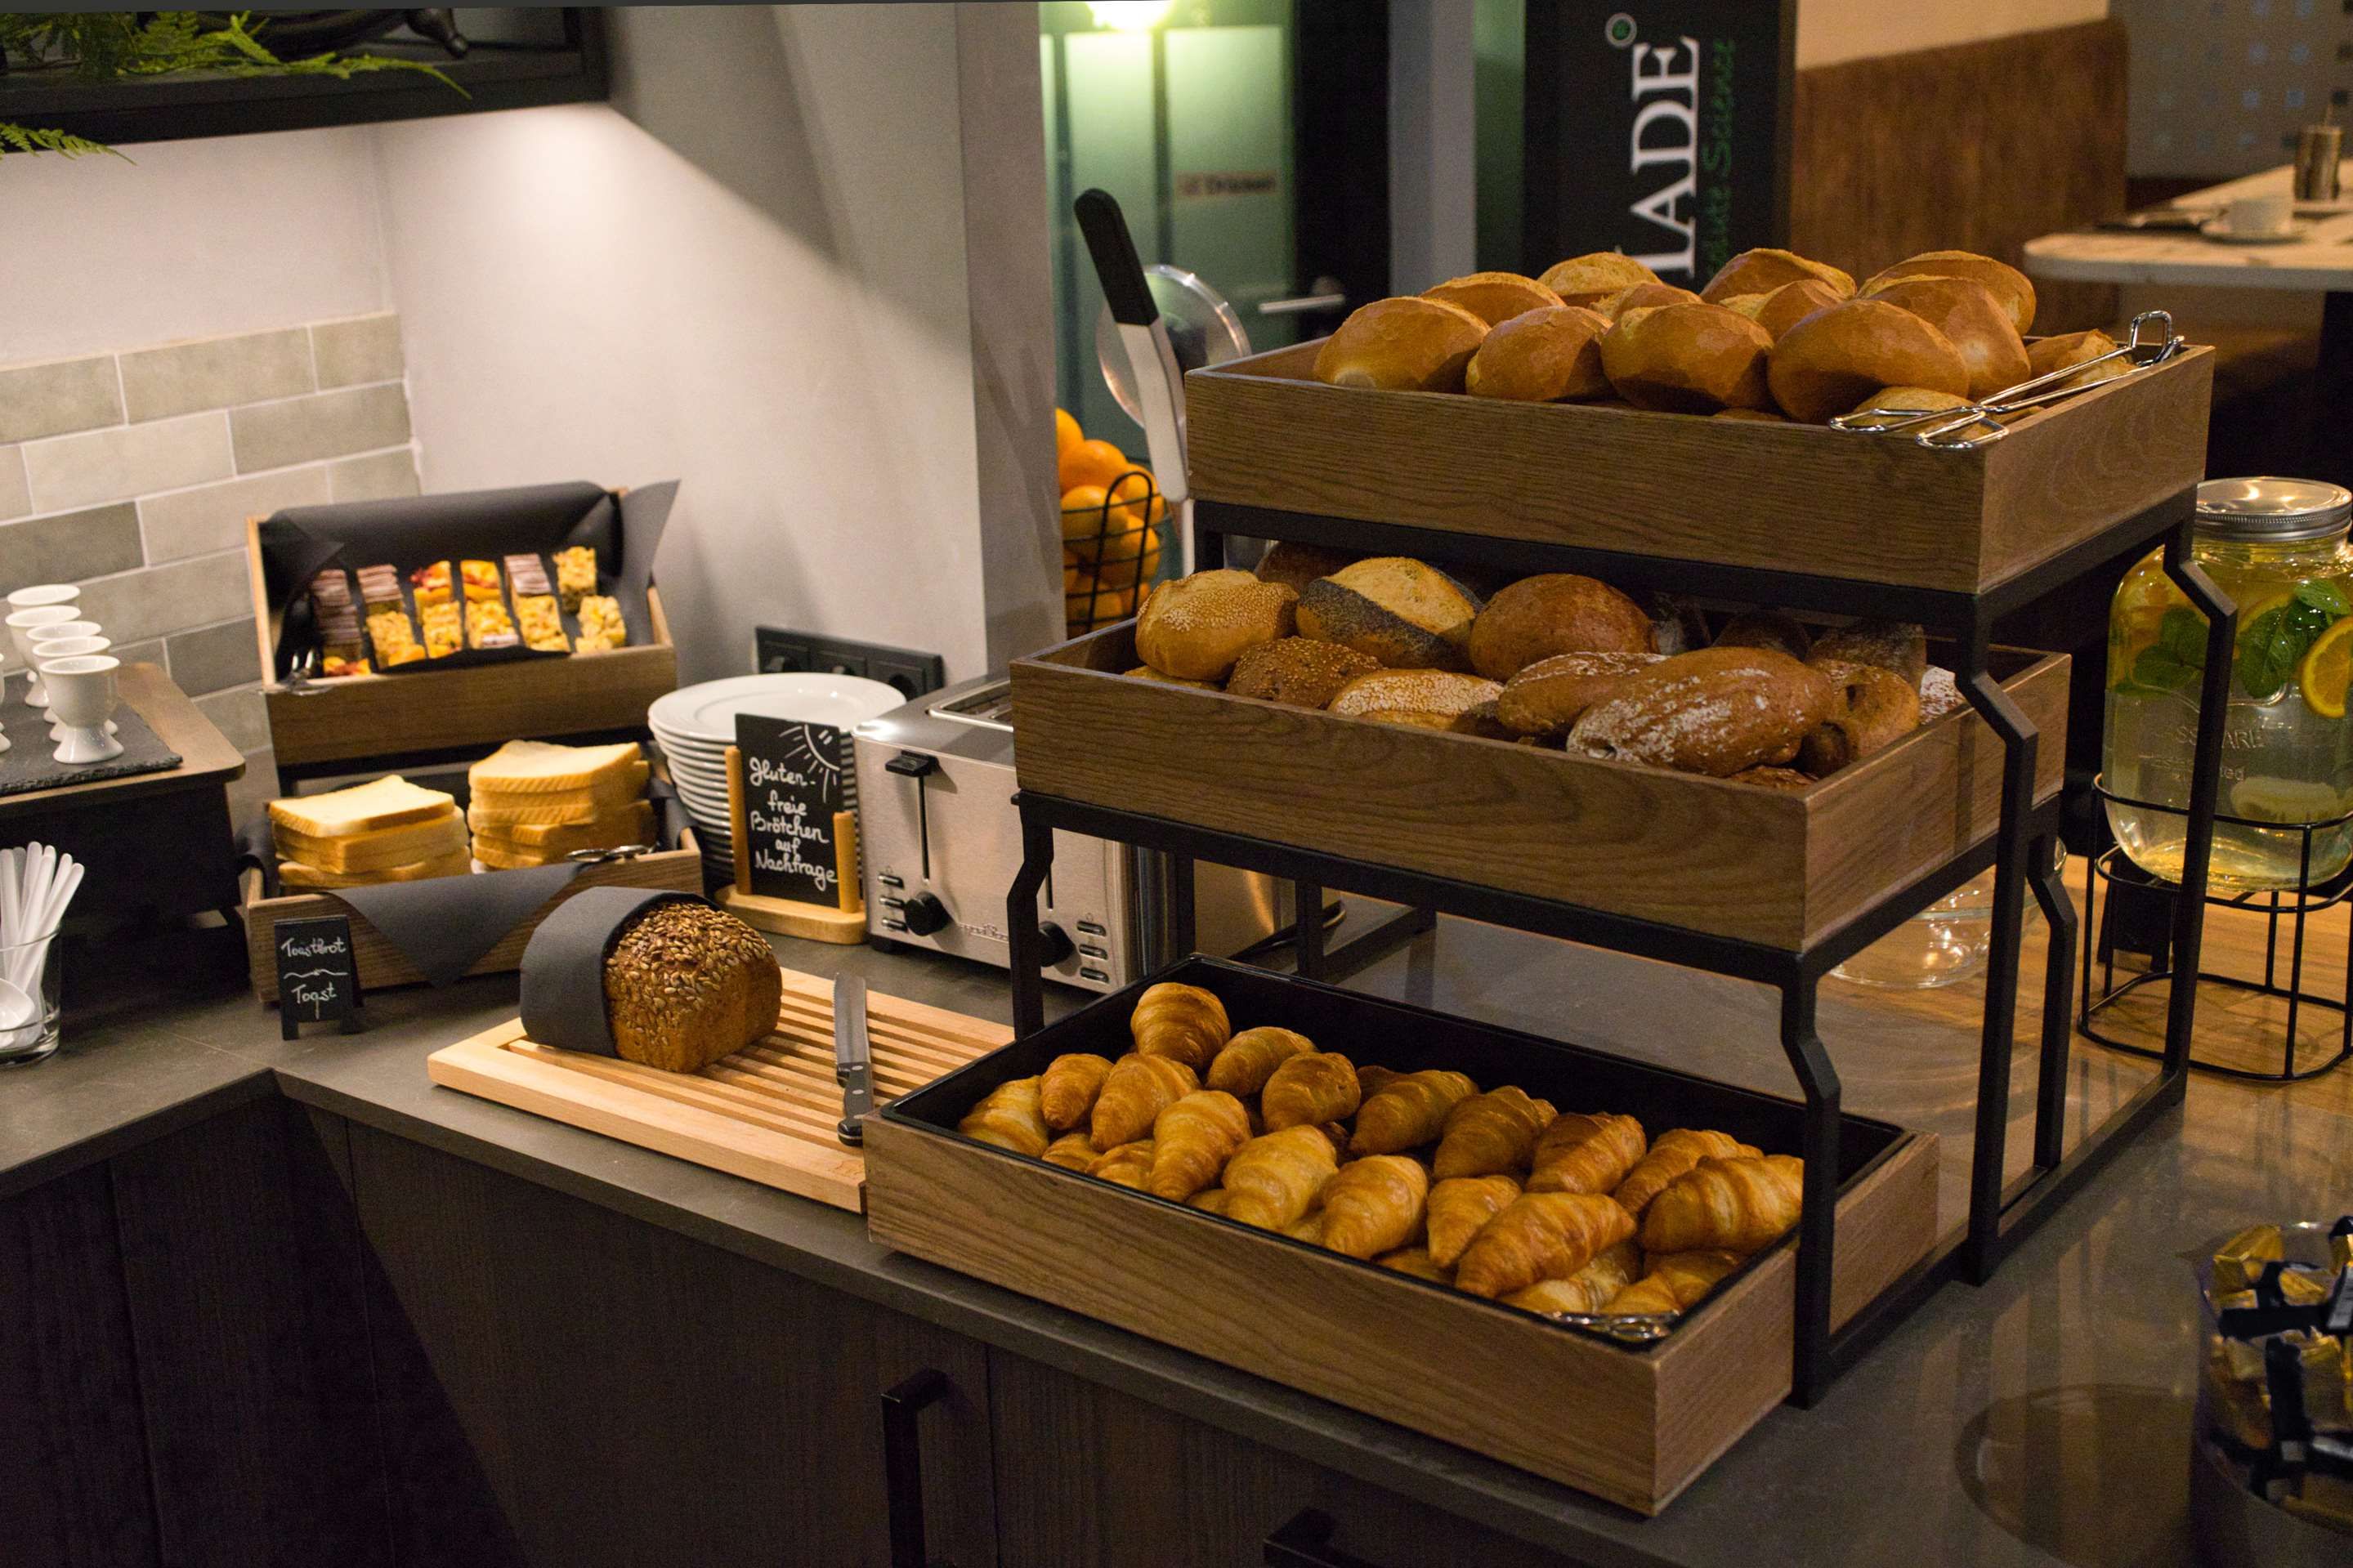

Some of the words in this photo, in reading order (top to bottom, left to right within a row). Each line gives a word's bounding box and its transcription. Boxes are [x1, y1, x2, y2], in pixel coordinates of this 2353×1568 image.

[767, 789, 807, 816] freie
[749, 810, 830, 844] Brötchen
[775, 836, 802, 855] auf
[755, 847, 839, 892] Nachfrage
[290, 981, 338, 1004] Toast
